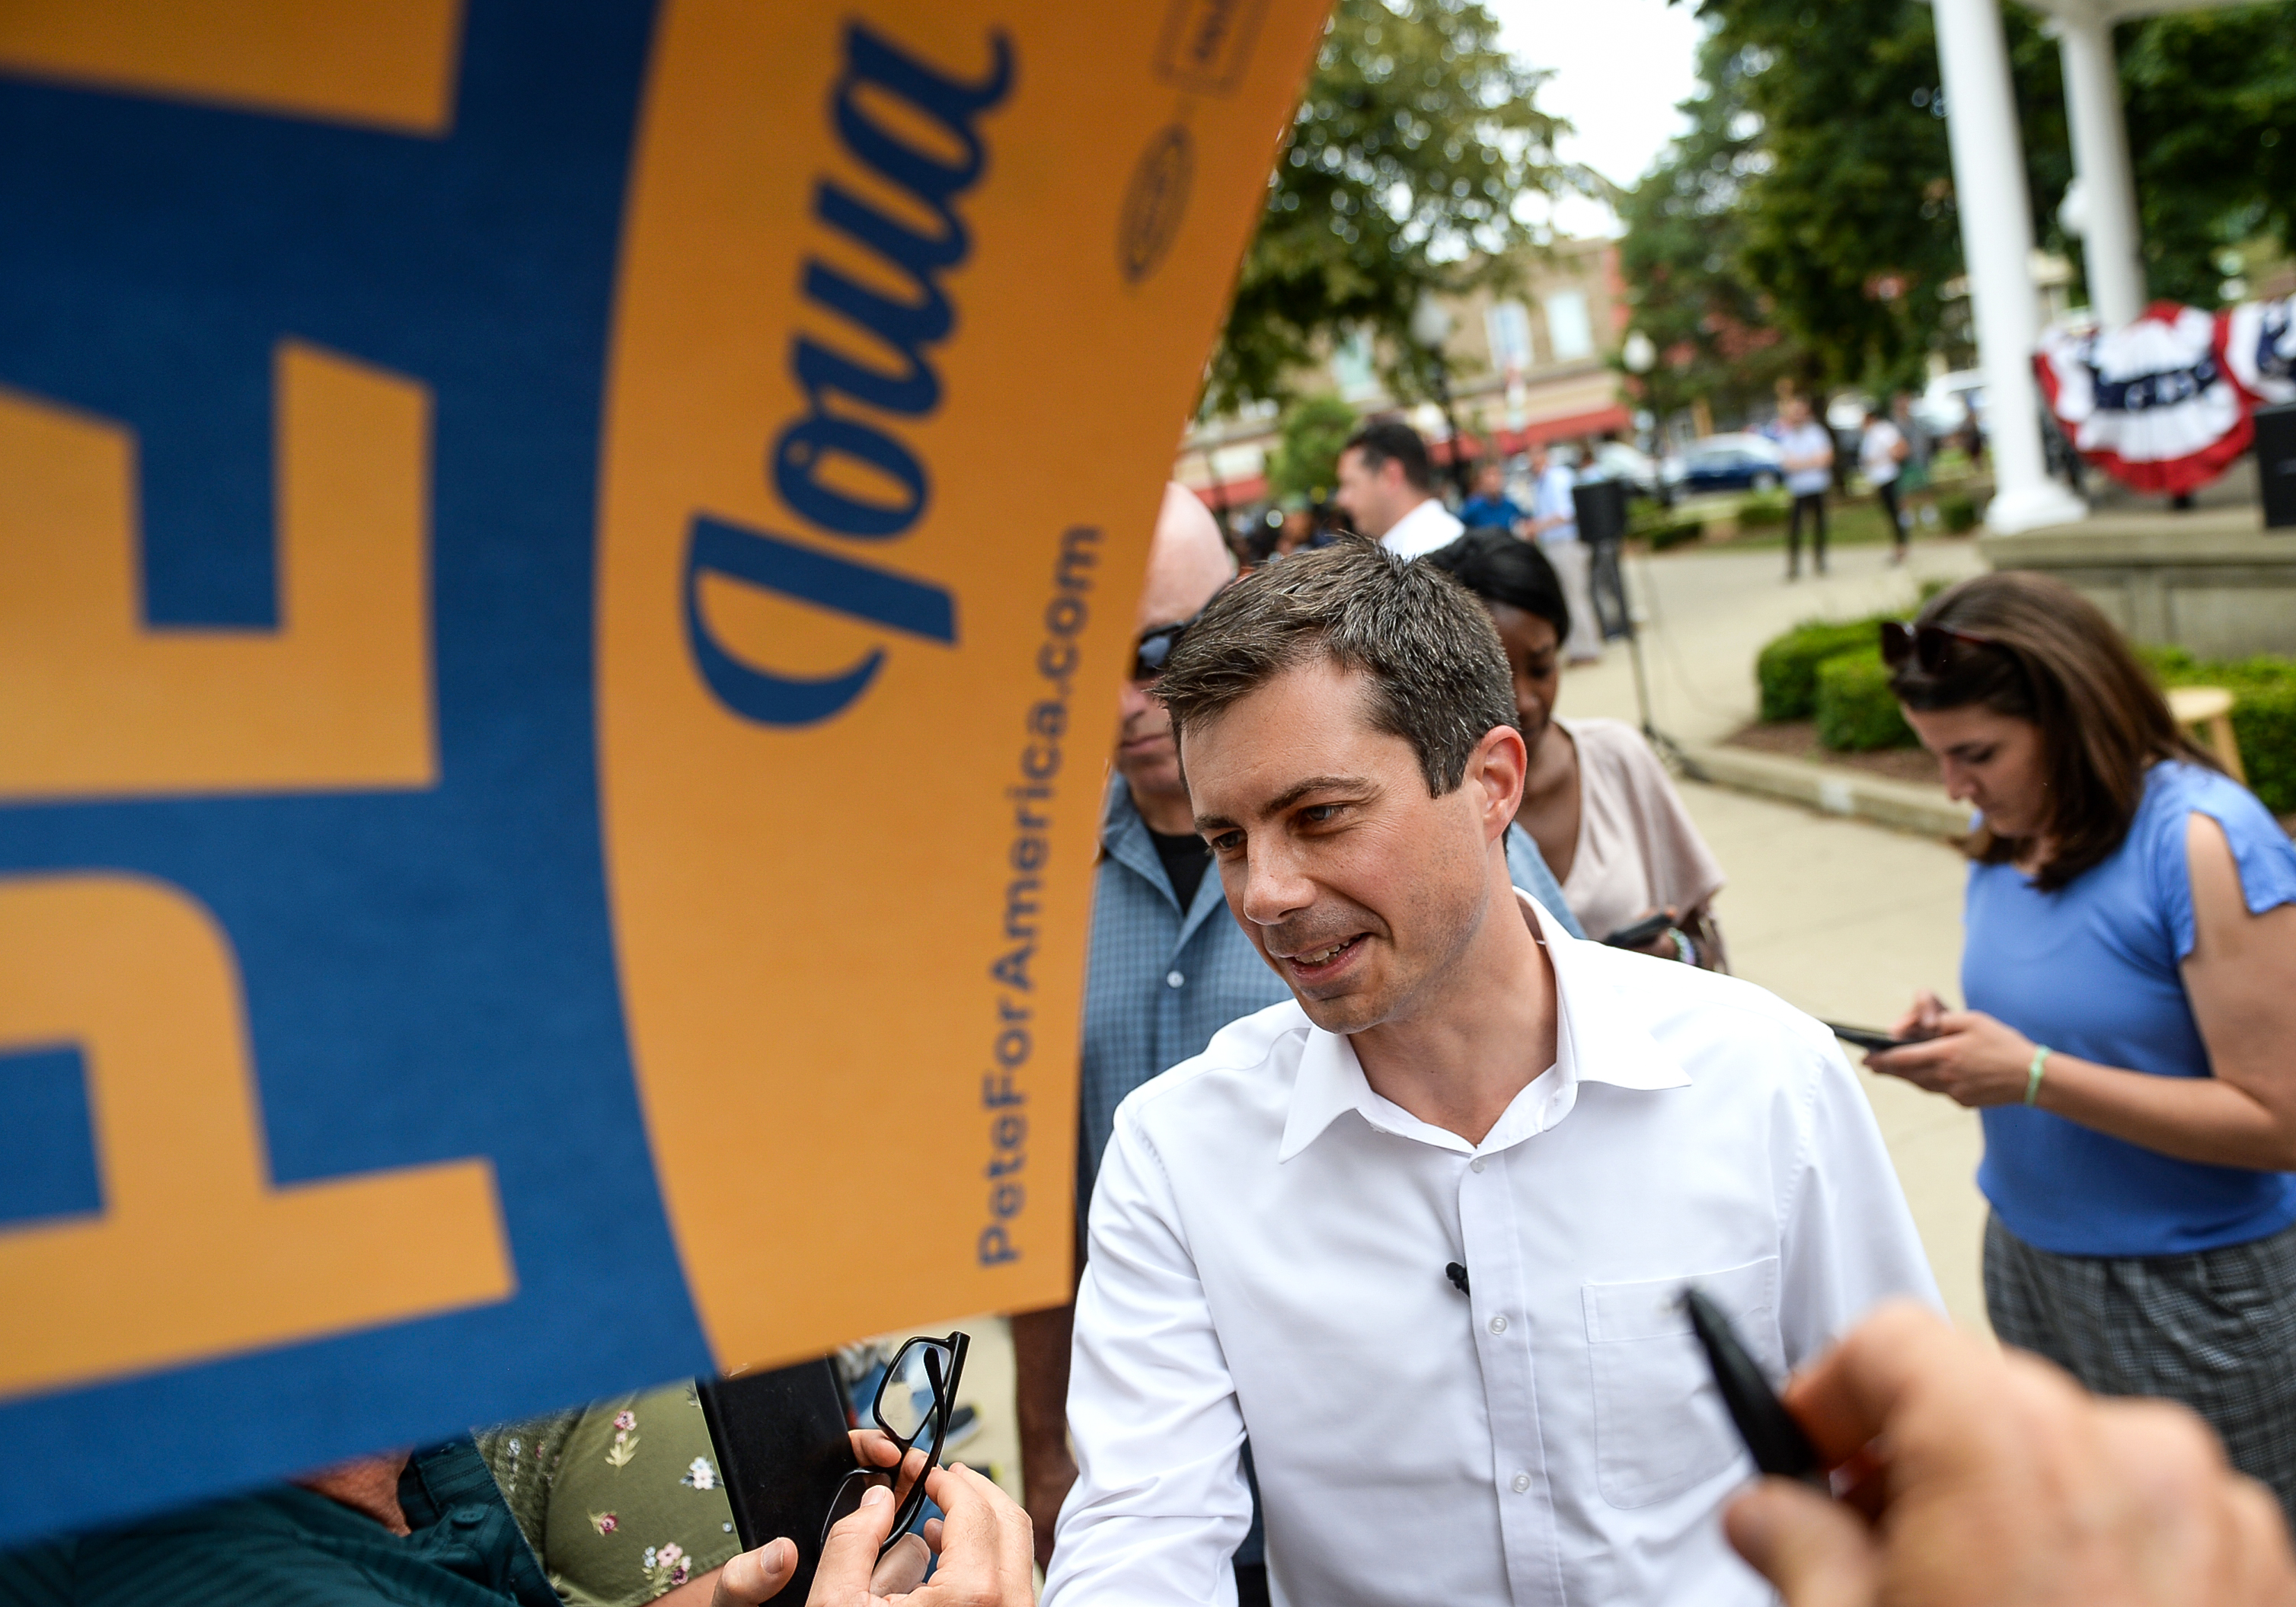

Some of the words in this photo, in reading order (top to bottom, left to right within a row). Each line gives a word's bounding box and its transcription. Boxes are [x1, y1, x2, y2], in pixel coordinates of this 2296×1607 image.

[0, 0, 519, 1398] PE
[679, 20, 1017, 731] Iowa
[978, 526, 1100, 1267] PeteForAmerica.com
